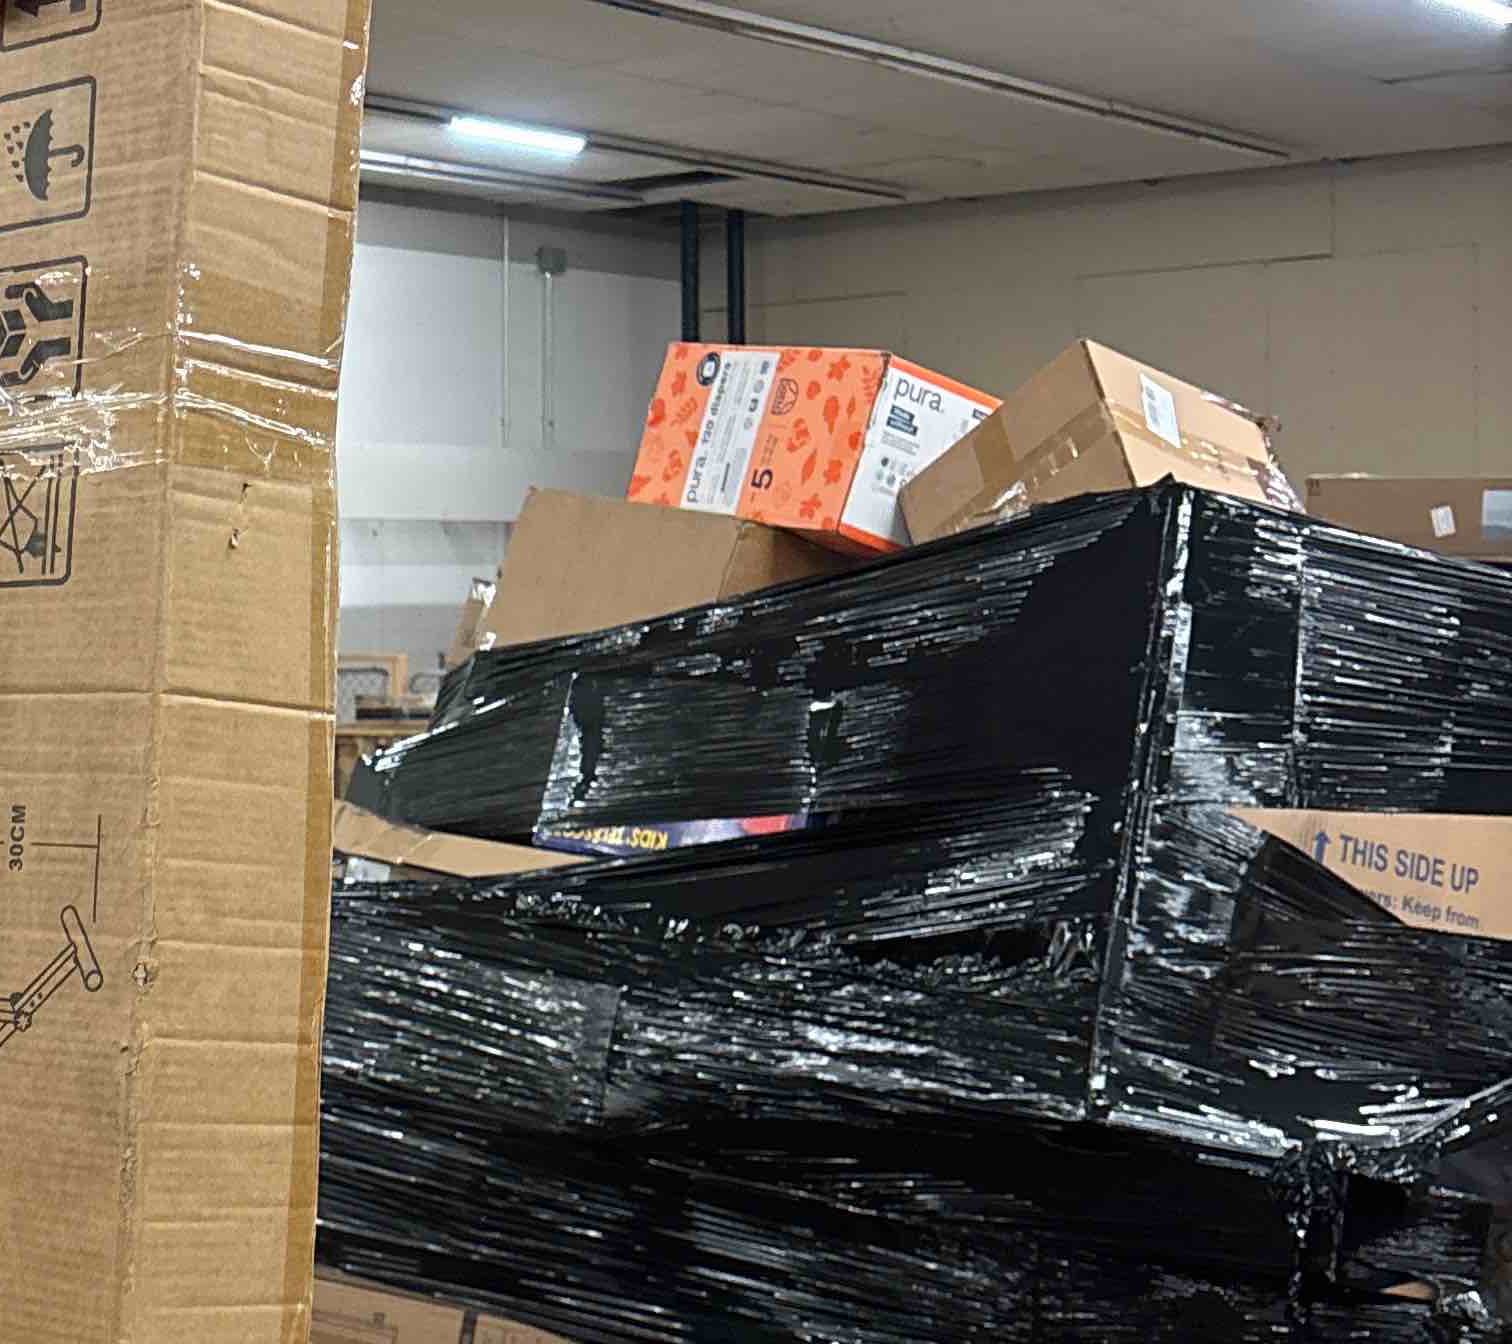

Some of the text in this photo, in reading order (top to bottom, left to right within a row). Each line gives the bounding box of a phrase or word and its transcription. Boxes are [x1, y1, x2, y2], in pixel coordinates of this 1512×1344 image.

[750, 468, 774, 490] 5
[8, 804, 27, 872] 30CM
[1339, 832, 1480, 895] THIS SIDE UP
[1401, 895, 1441, 922] Keep
[1445, 906, 1481, 929] from
